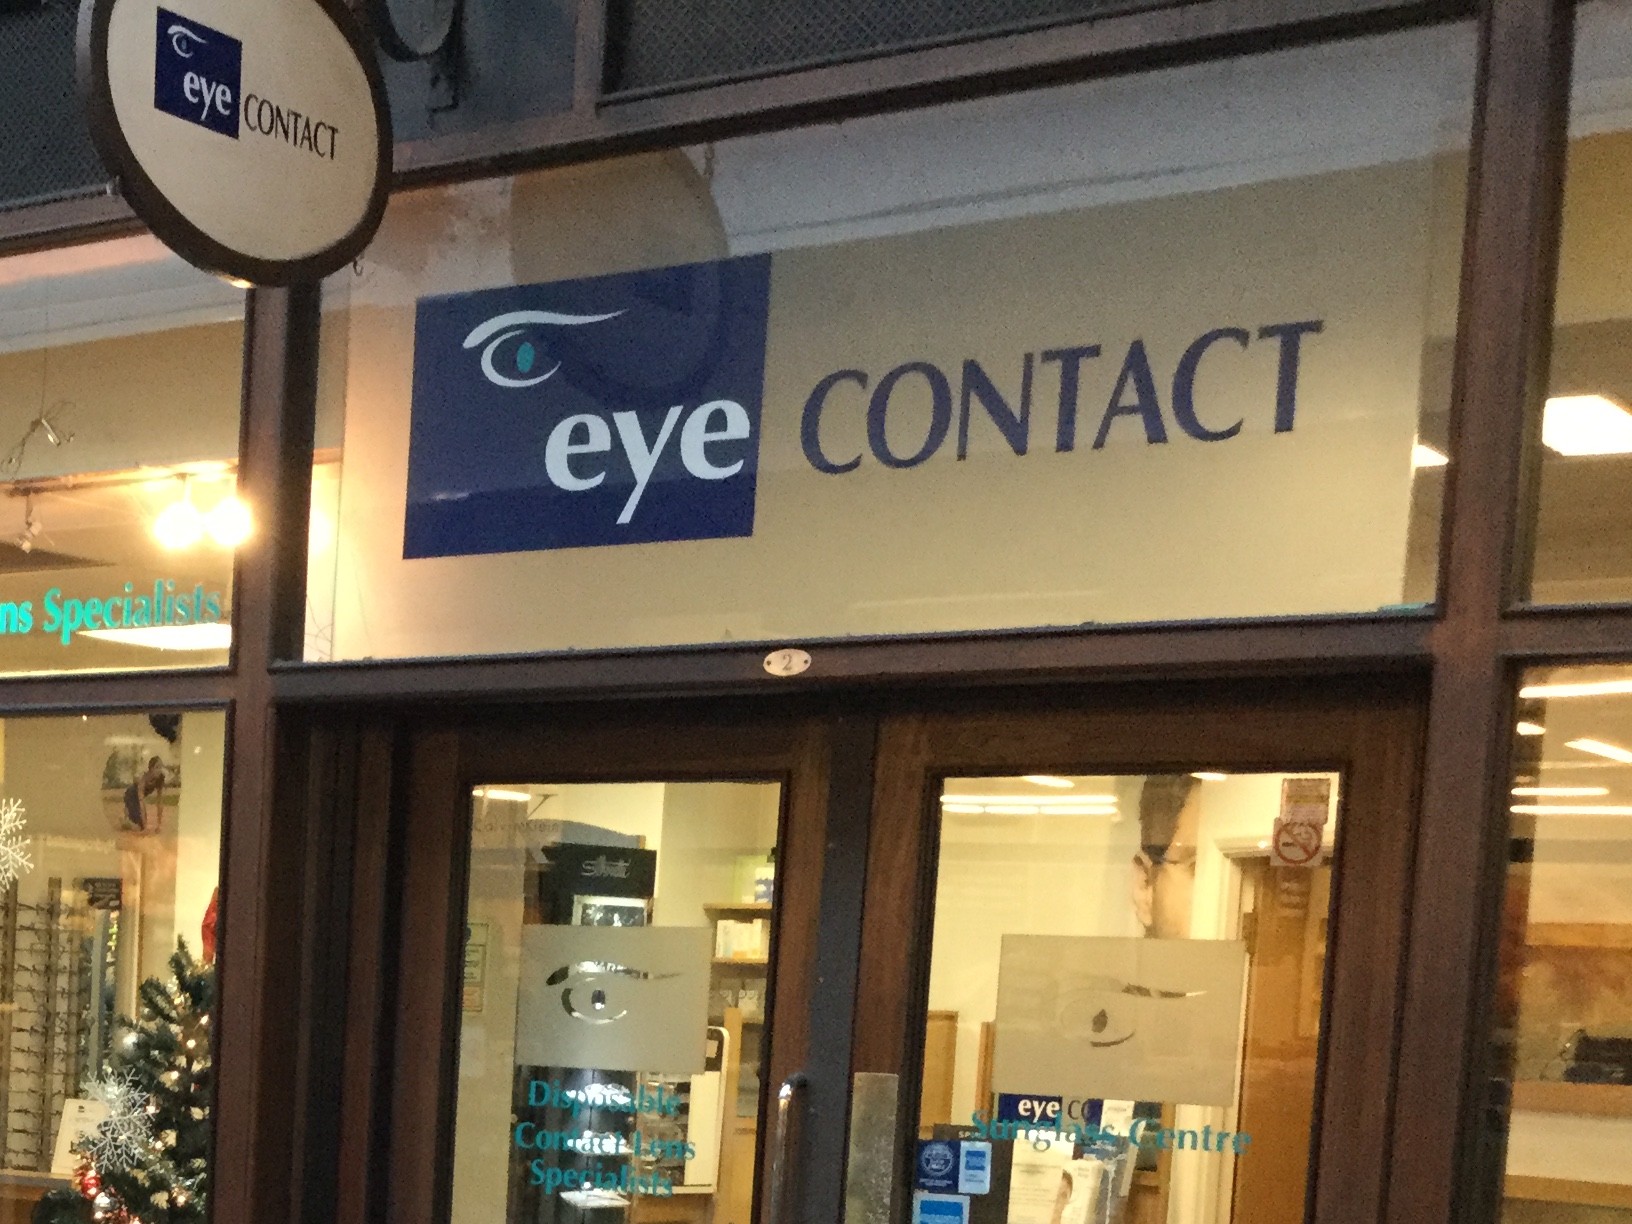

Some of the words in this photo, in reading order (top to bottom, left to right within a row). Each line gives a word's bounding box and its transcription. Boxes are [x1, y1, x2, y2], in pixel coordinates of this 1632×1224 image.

[183, 71, 232, 121] eye
[244, 93, 339, 160] CONTACT
[545, 399, 750, 525] eye
[800, 320, 1324, 475] CONTACT
[43, 579, 222, 645] Specialists
[782, 653, 793, 671] 2
[528, 1079, 681, 1119] Disposable
[1018, 1098, 1061, 1123] eye
[514, 1121, 624, 1155] Contact
[633, 1130, 696, 1161] Lens
[972, 1109, 1118, 1153] Sunglass
[1129, 1116, 1253, 1155] Centre
[530, 1158, 674, 1198] Specialists
